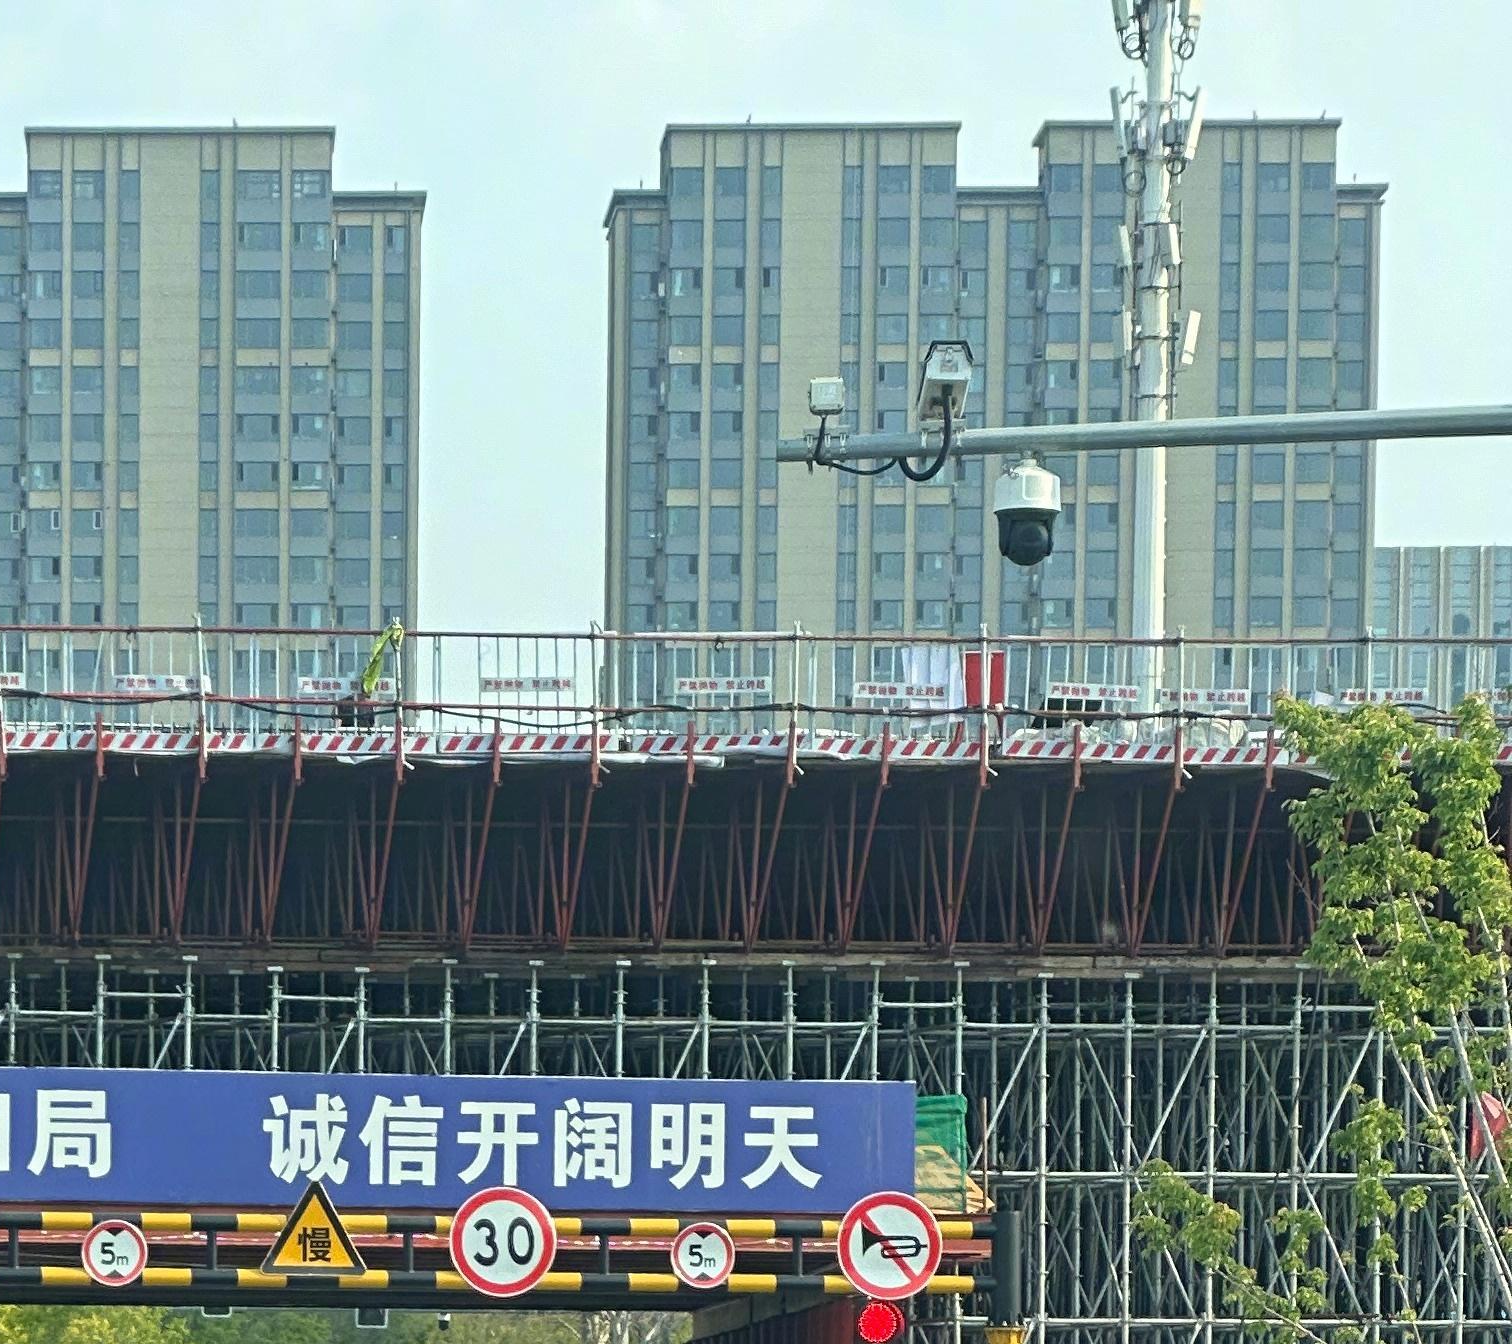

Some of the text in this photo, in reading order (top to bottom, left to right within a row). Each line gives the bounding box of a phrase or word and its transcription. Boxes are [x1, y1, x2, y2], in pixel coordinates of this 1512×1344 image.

[262, 1093, 823, 1190] 诚信开阔明天
[100, 1242, 129, 1268] 5m
[296, 1226, 333, 1263] 慢
[473, 1218, 535, 1265] 30
[688, 1244, 718, 1270] 5m
